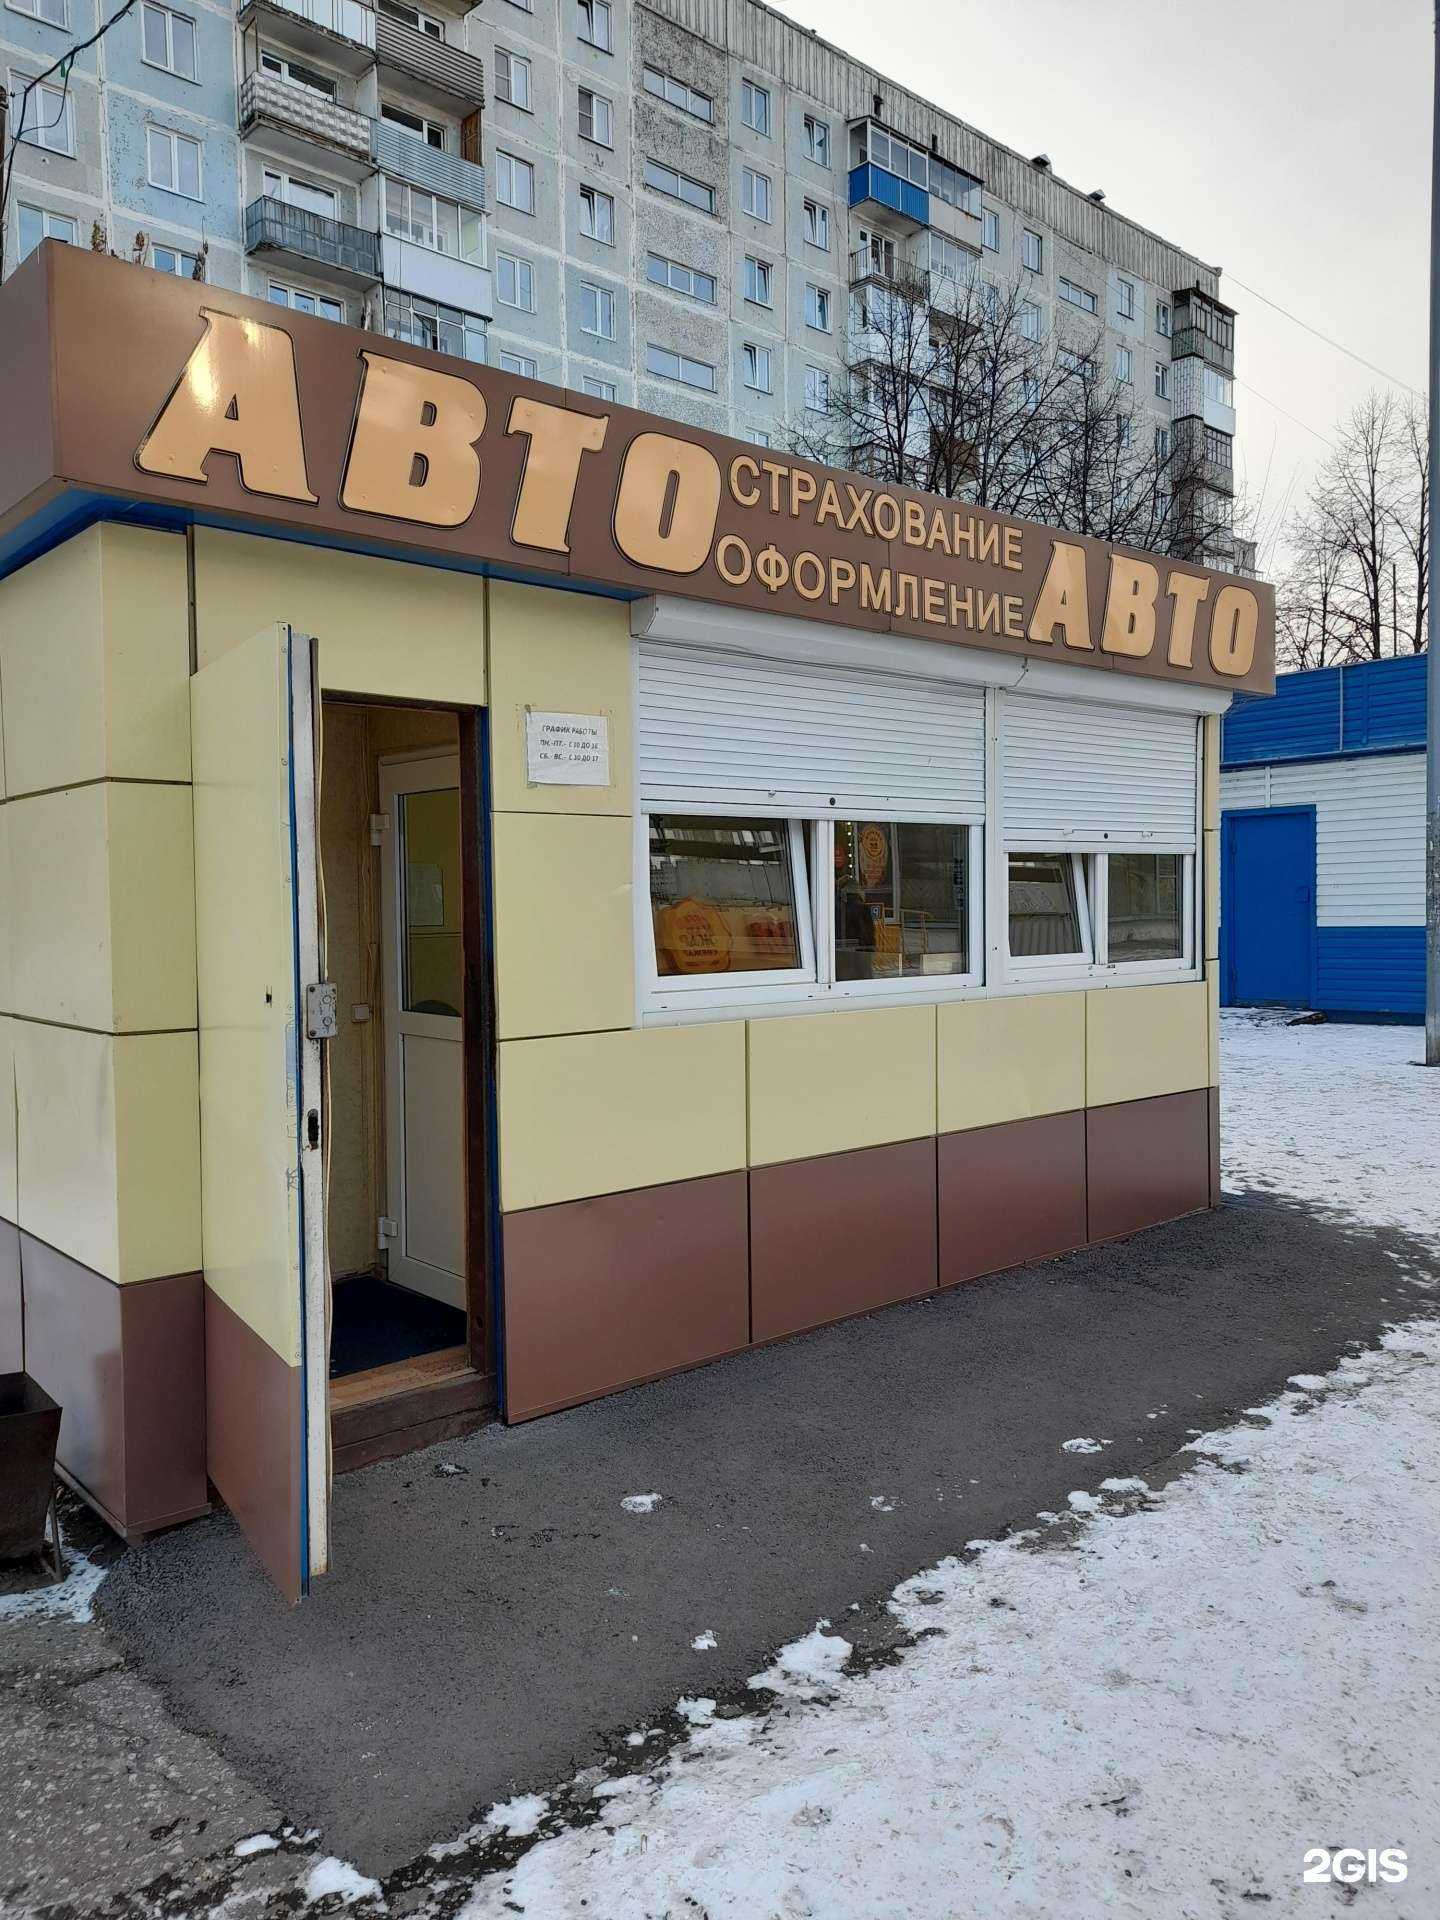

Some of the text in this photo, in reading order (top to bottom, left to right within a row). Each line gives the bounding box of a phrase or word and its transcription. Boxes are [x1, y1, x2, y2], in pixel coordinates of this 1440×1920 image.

[133, 306, 722, 576] АВТО
[728, 454, 1024, 572] СТРАХОВАНИЕ
[714, 533, 1025, 639] ОФОРМЛЕНИЕ
[1027, 539, 1259, 677] АВТО
[542, 725, 598, 736] ГРАФИК РАБОТЫ
[580, 742, 591, 750] ДО
[581, 754, 591, 762] ДО
